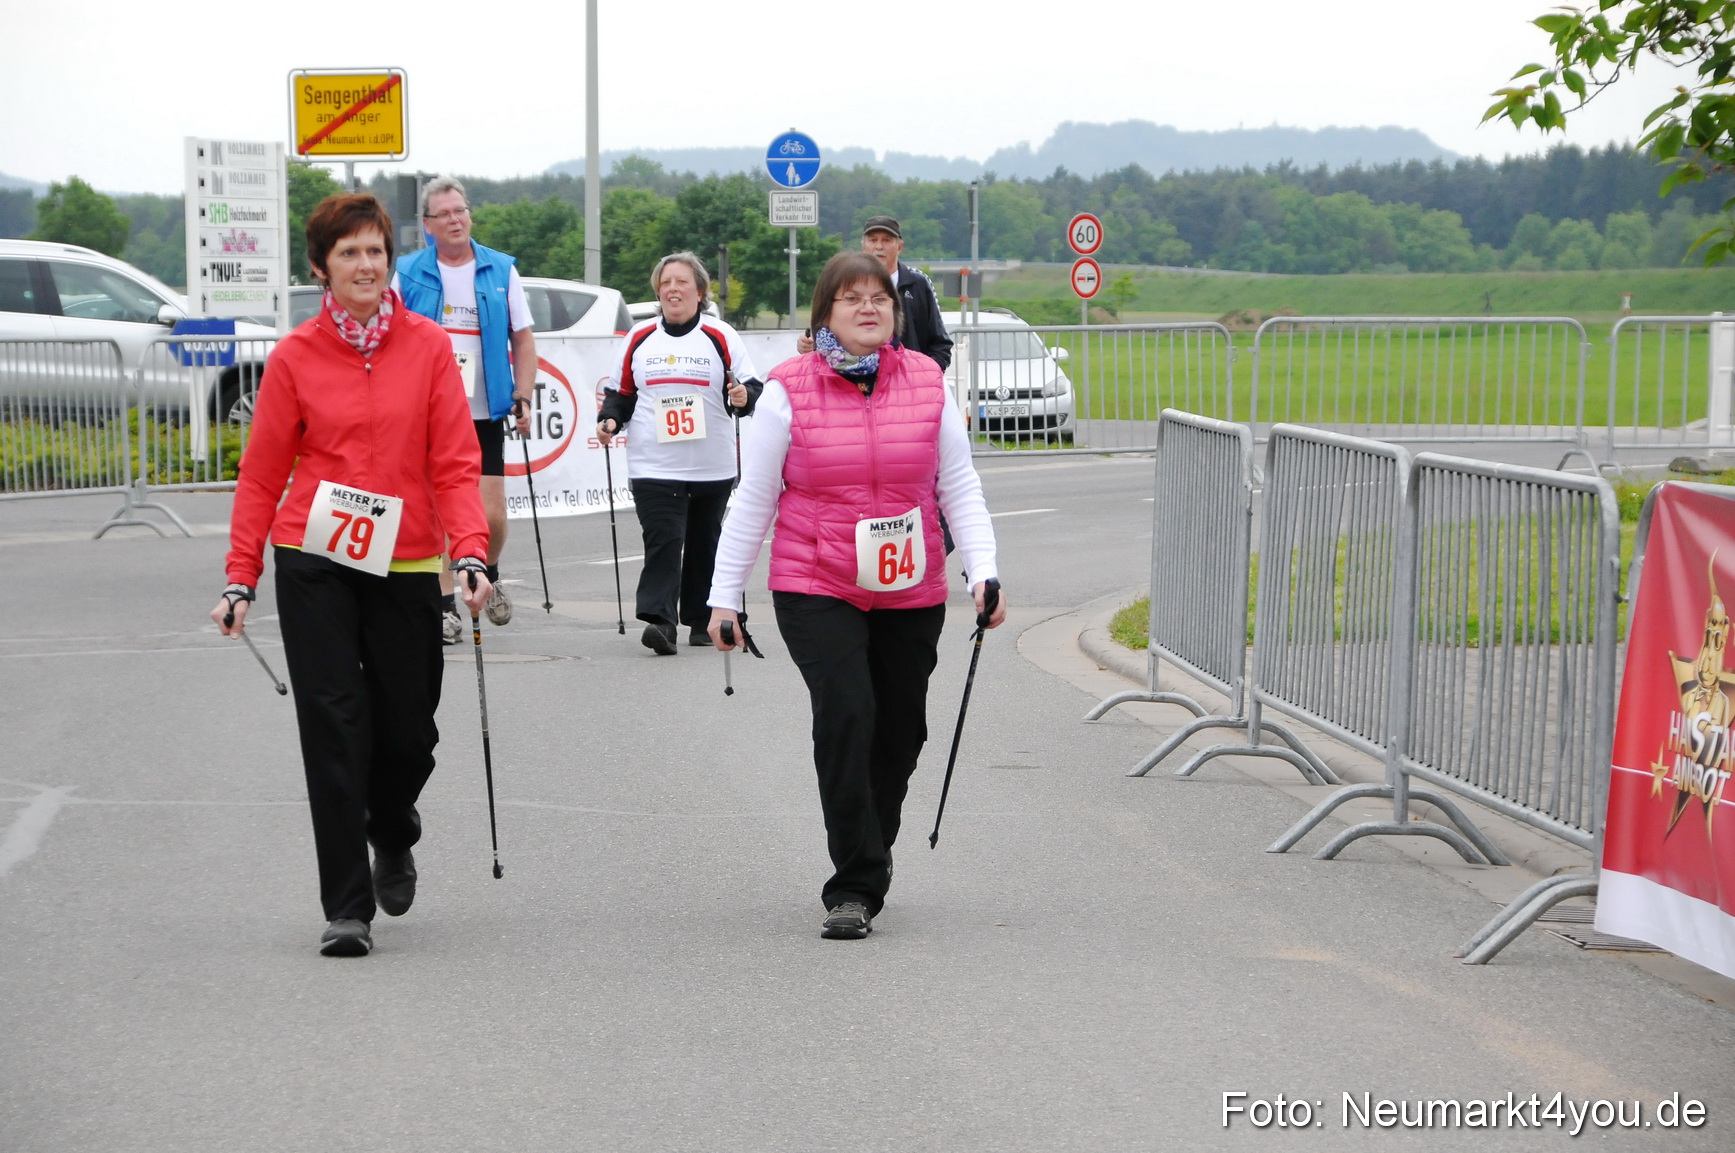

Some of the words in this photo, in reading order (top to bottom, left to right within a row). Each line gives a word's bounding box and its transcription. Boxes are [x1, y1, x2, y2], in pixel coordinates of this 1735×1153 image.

[304, 84, 393, 109] Sengenthal
[316, 113, 336, 122] am
[343, 111, 381, 125] Anger
[326, 134, 365, 144] Neumarkt
[1076, 225, 1095, 243] 60
[209, 262, 242, 282] THULE
[661, 396, 684, 404] MEYER
[666, 408, 695, 436] 95
[329, 497, 369, 512] WERBUNG
[331, 487, 370, 505] MEYER
[562, 490, 584, 507] Tel.
[870, 519, 904, 531] MEYER
[870, 528, 905, 538] WERBUNG
[326, 509, 374, 560] 79
[878, 536, 915, 585] 64
